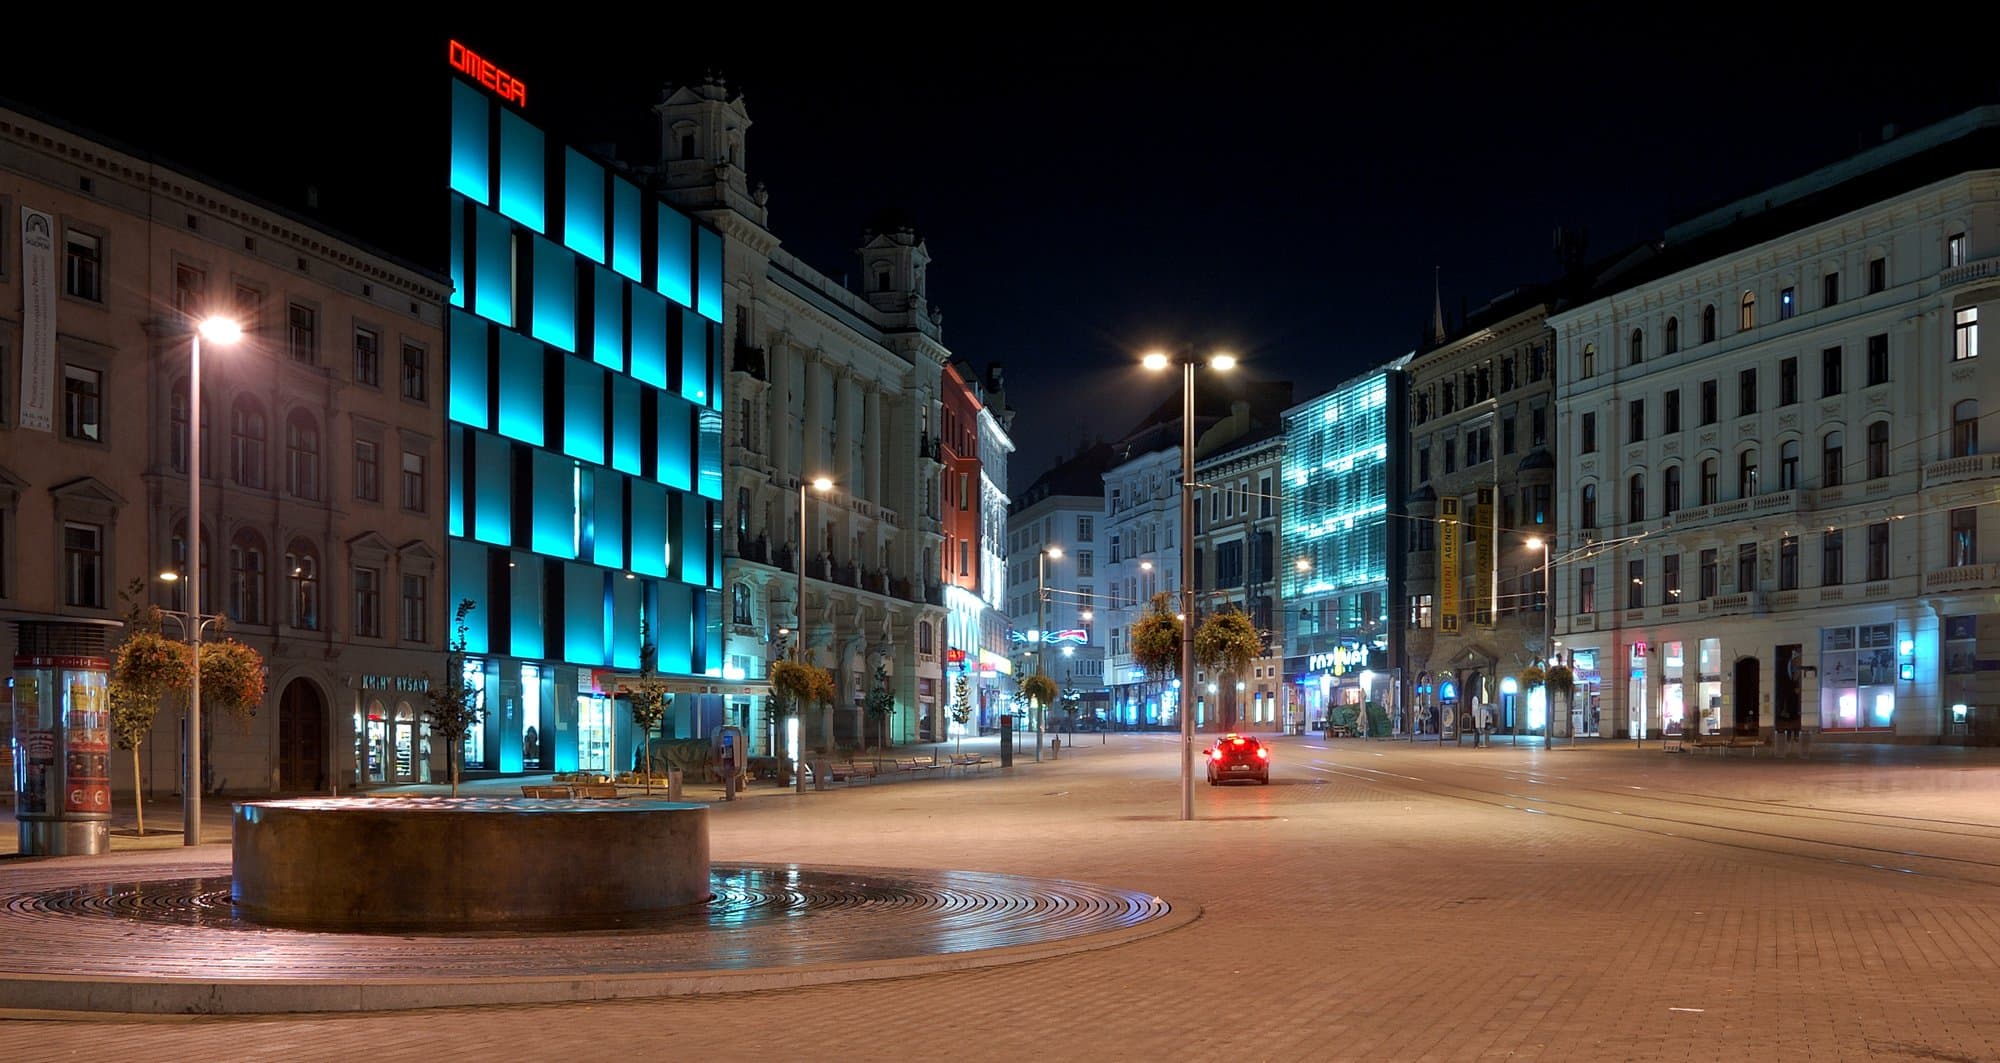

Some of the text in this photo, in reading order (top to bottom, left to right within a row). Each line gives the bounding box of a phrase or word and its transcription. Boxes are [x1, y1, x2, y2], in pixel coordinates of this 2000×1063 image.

[449, 39, 526, 108] OMEGA
[1444, 566, 1452, 607] STUDENT
[1637, 642, 1647, 656] T
[362, 674, 392, 691] KNIHY
